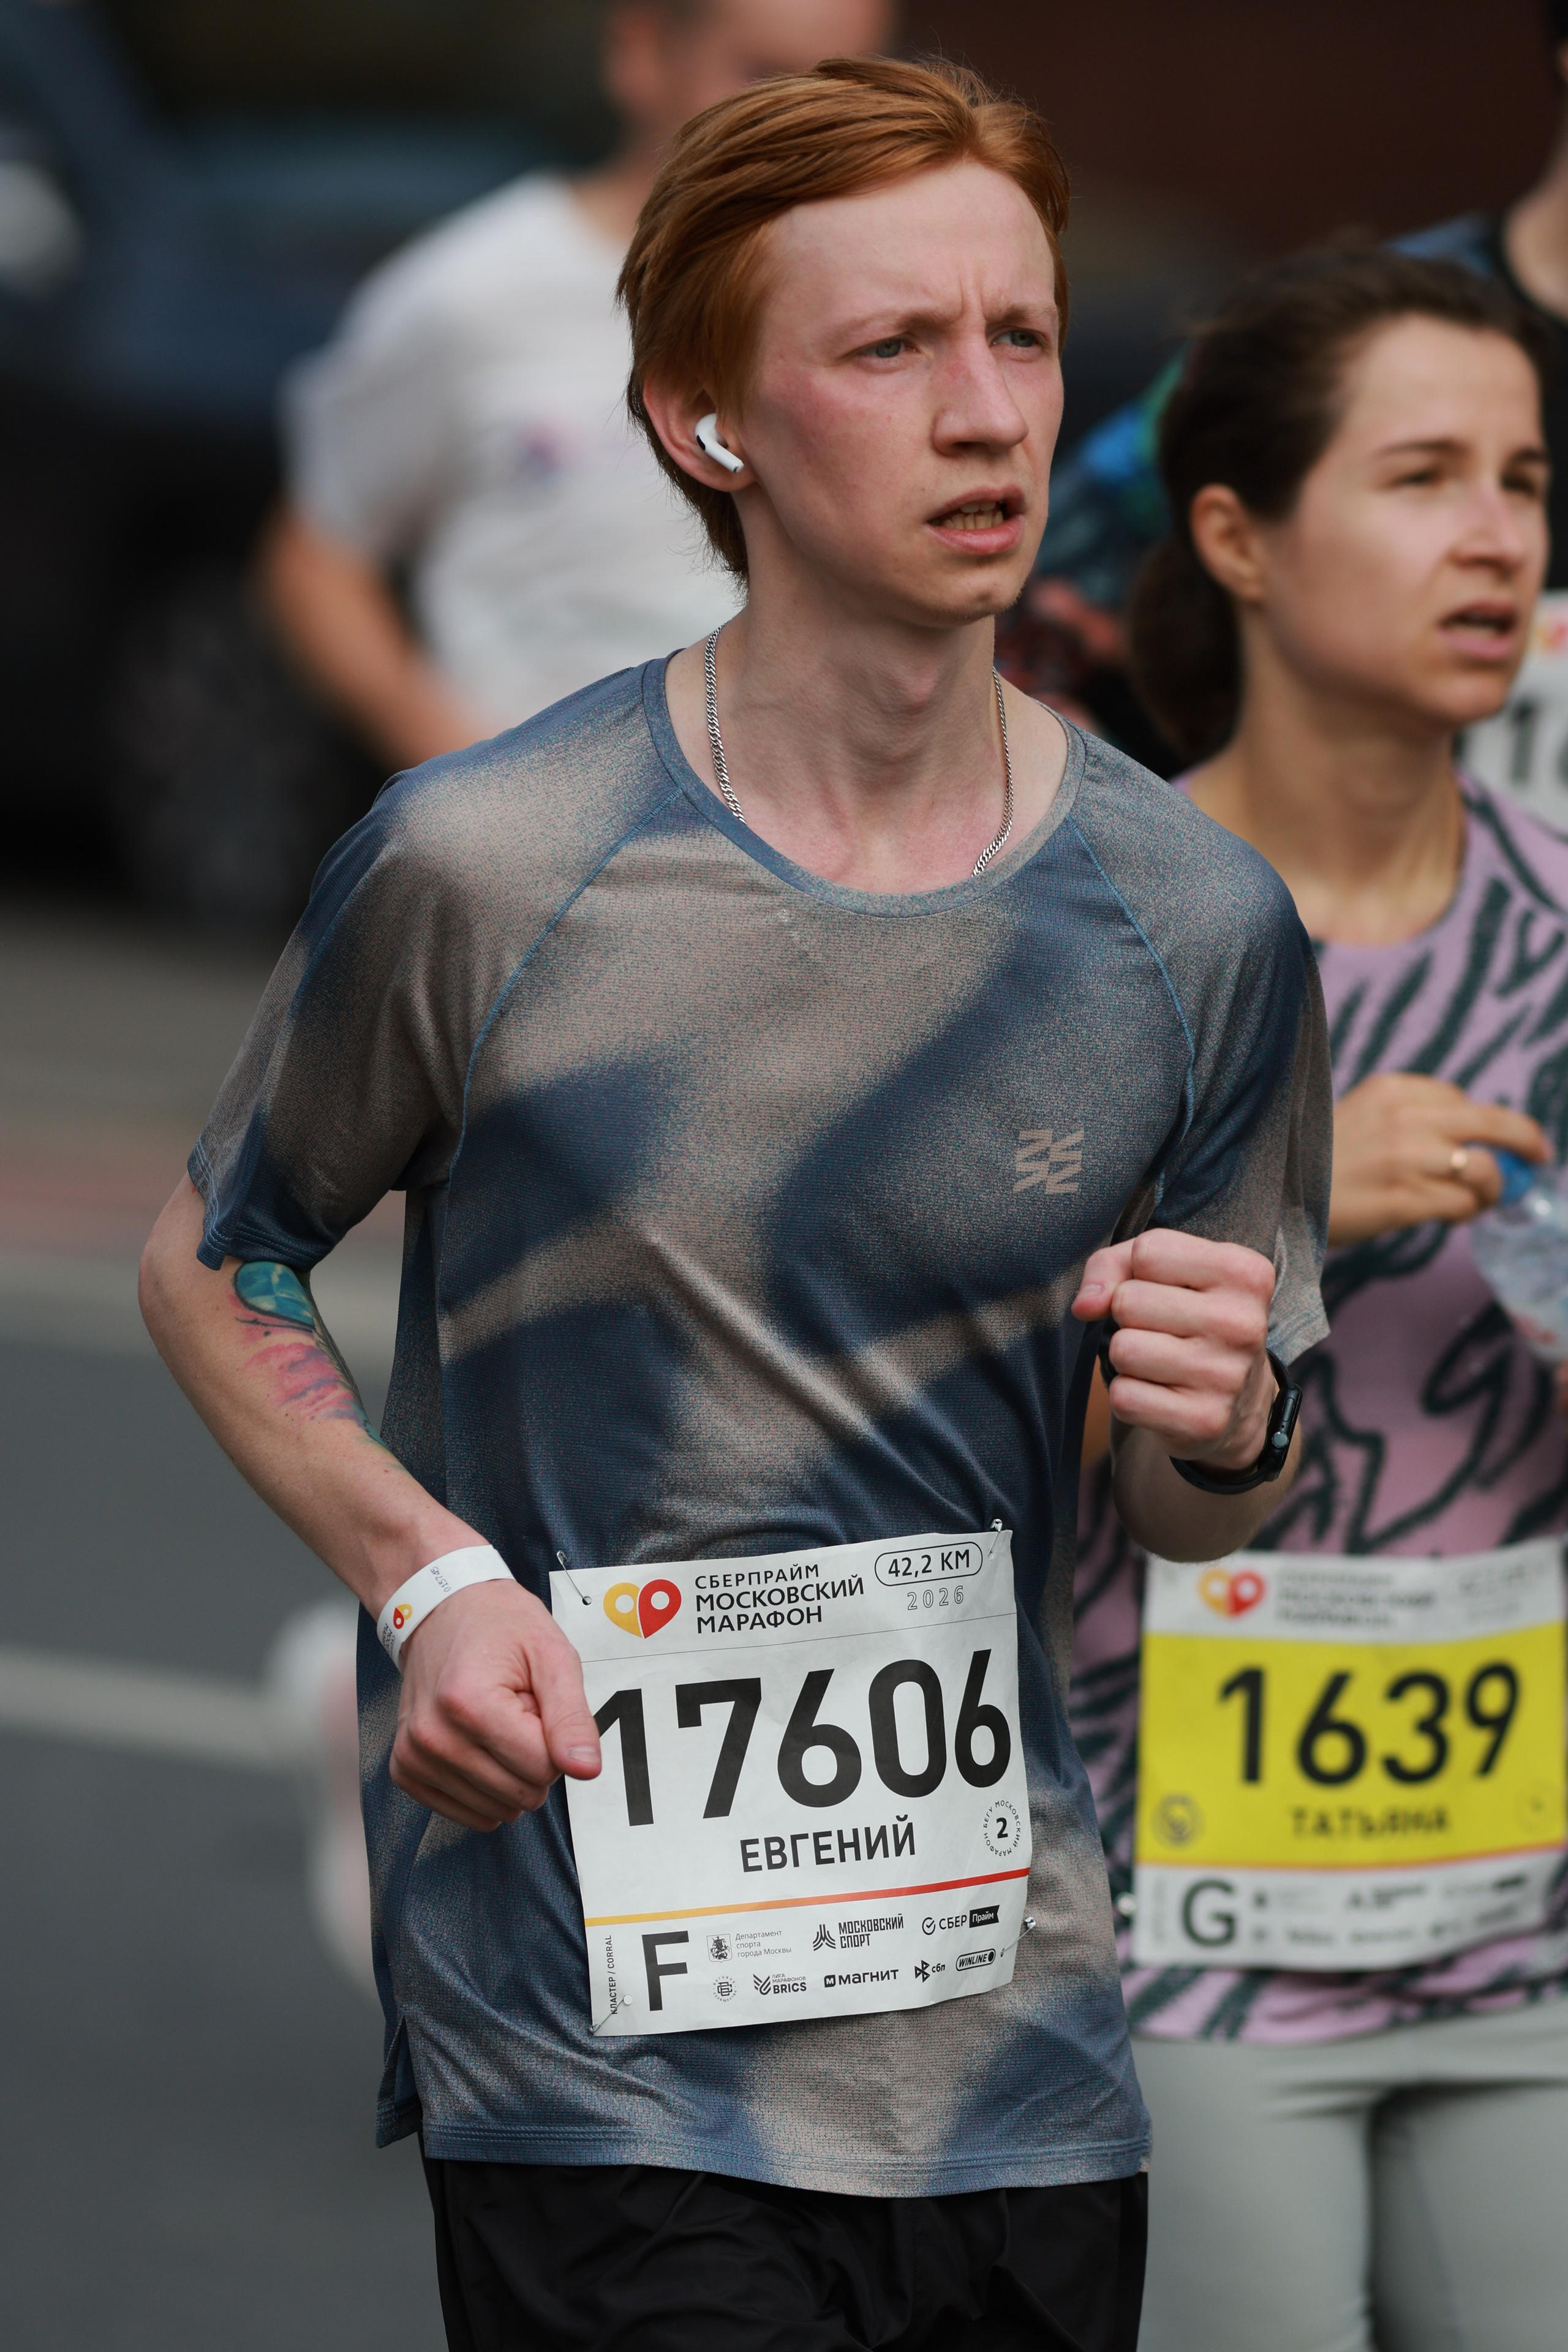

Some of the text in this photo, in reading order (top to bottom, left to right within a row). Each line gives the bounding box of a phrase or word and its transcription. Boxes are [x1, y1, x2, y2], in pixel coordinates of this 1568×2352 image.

[695, 1562, 820, 1589] СБЕРПРАЙМ
[888, 1549, 970, 1578] 42,2 КМ
[695, 1574, 865, 1612] МОСКОВСКИЙ
[907, 1585, 964, 1611] 2026
[696, 1605, 823, 1634] МАРАФОН
[1219, 1660, 1521, 1788] 1639
[594, 1649, 1011, 1826] 17606
[983, 1806, 993, 1828] БЕГУ
[996, 1817, 1008, 1839] 2
[740, 1814, 916, 1872] ЕВГЕНИЙ
[984, 1832, 1012, 1856] МАРАФОН
[839, 1913, 904, 1935] МОСКОВСКИЙ
[939, 1911, 994, 1929] СБЕР Прайм
[1182, 1879, 1237, 1947] G
[735, 1931, 783, 1941] Департамент
[736, 1941, 761, 1950] спорта
[840, 1933, 871, 1948] СПОРТ
[605, 1935, 615, 1969] CORRAL
[959, 1953, 988, 1967] WINLINE
[641, 1930, 690, 2011] F
[931, 1962, 946, 1973] сбп
[608, 1977, 618, 2015] КЛАСТЕР
[772, 1982, 807, 1994] BRICS
